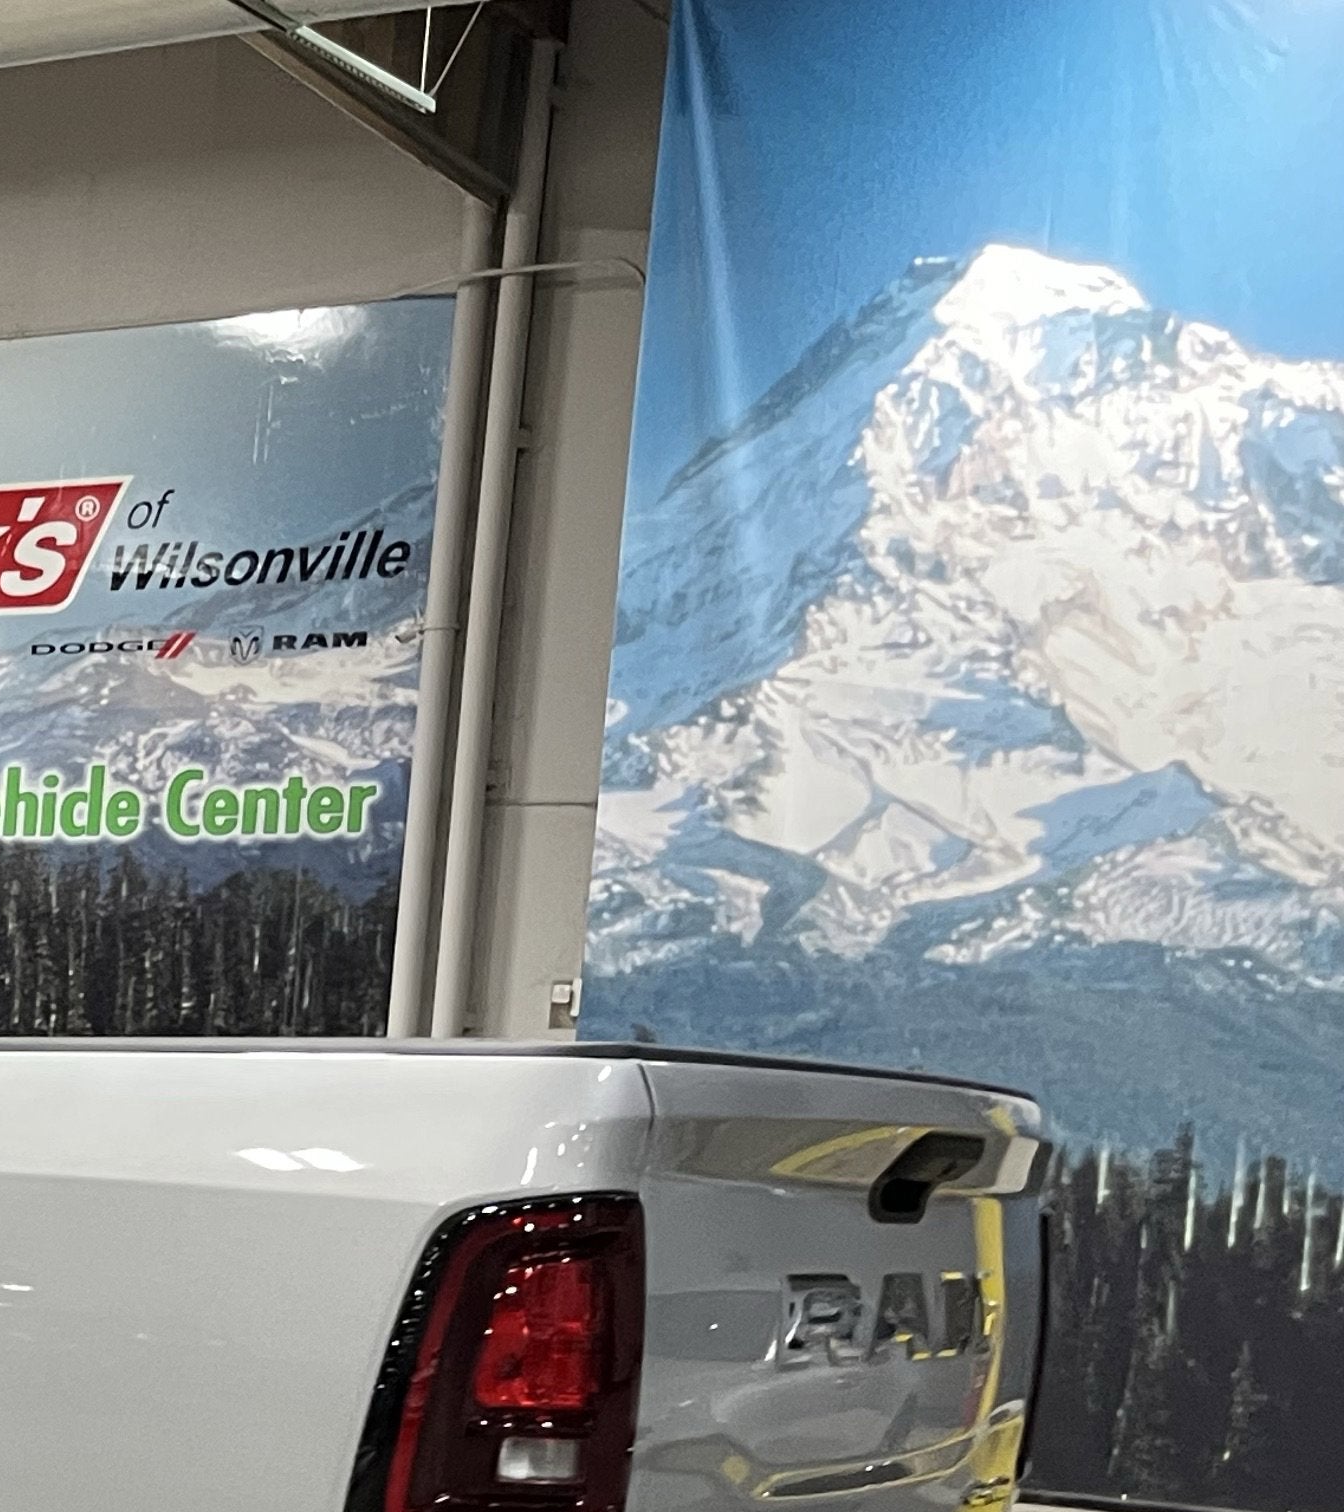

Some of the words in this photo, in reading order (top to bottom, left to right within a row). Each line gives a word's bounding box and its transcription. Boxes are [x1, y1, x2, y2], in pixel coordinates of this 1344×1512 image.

[127, 489, 175, 530] of
[109, 530, 411, 591] Wilsonville
[272, 631, 368, 651] RAM
[166, 769, 377, 836] Center
